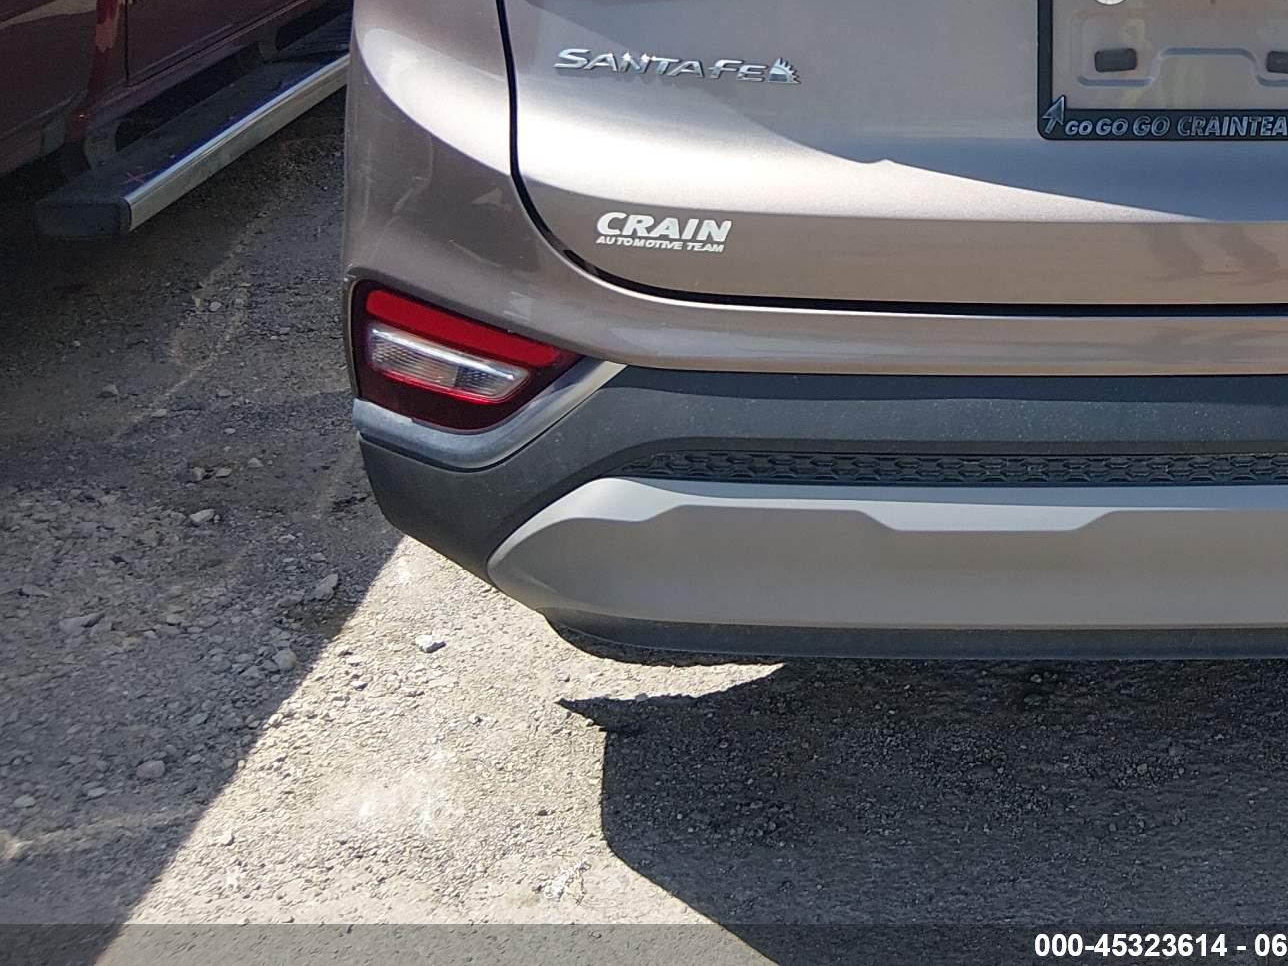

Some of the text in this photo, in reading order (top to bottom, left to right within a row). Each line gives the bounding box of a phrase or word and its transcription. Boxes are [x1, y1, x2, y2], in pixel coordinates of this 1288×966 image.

[554, 48, 704, 78] SANTA
[1065, 120, 1092, 136] GO
[1095, 117, 1129, 136] GO
[1132, 115, 1171, 136] GO
[596, 211, 732, 243] CRAIN
[595, 236, 725, 253] AUTOMOTIVE TEAM
